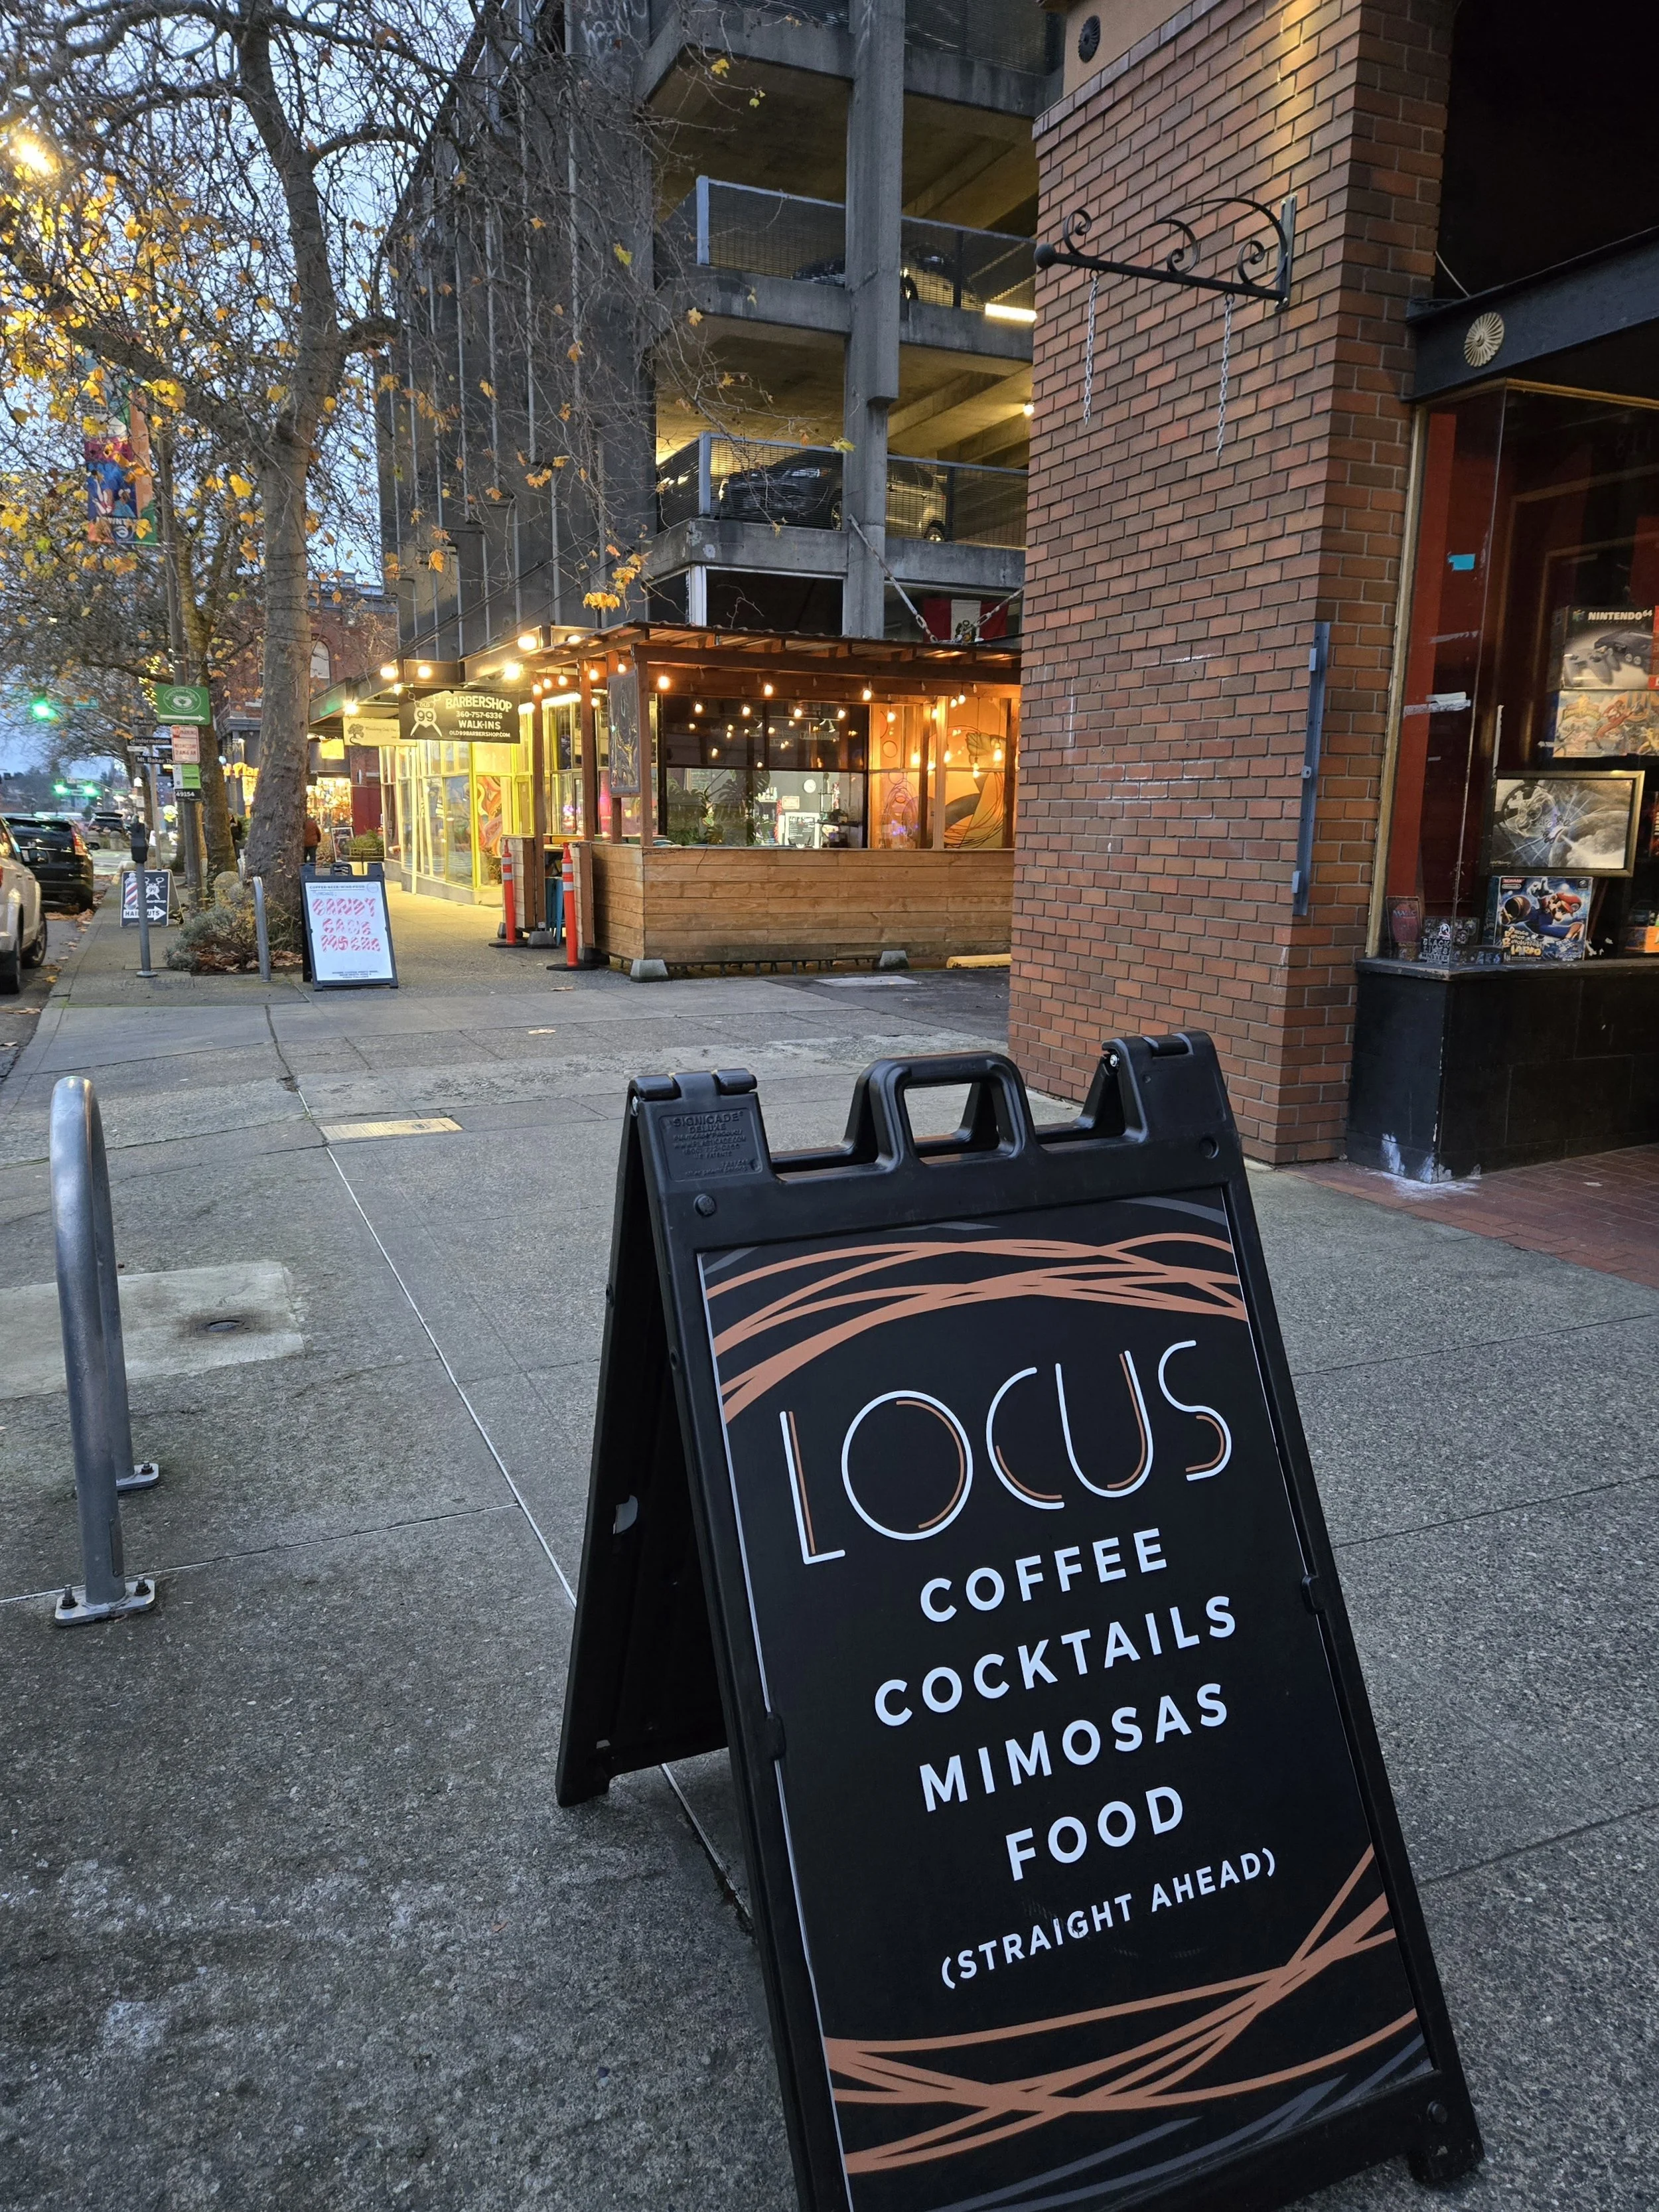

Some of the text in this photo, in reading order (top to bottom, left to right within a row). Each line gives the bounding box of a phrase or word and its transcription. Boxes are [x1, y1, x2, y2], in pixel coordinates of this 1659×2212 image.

[445, 695, 512, 712] BARBERSHOP
[417, 710, 434, 722] 99
[313, 898, 376, 917] CANDY
[323, 918, 372, 935] CANE
[321, 934, 381, 952] MOCHA
[1423, 938, 1450, 948] BLACK
[689, 1124, 727, 1134] DELUXE
[779, 1340, 1232, 1565] LOCUS
[920, 1528, 1167, 1623] COFFEE
[875, 1595, 1236, 1726] COCKTAILS
[920, 1683, 1228, 1812] MIMOSAS
[1006, 1787, 1183, 1881] FOOD
[941, 1848, 1275, 1989] (STRAIGHT AHEAD)
